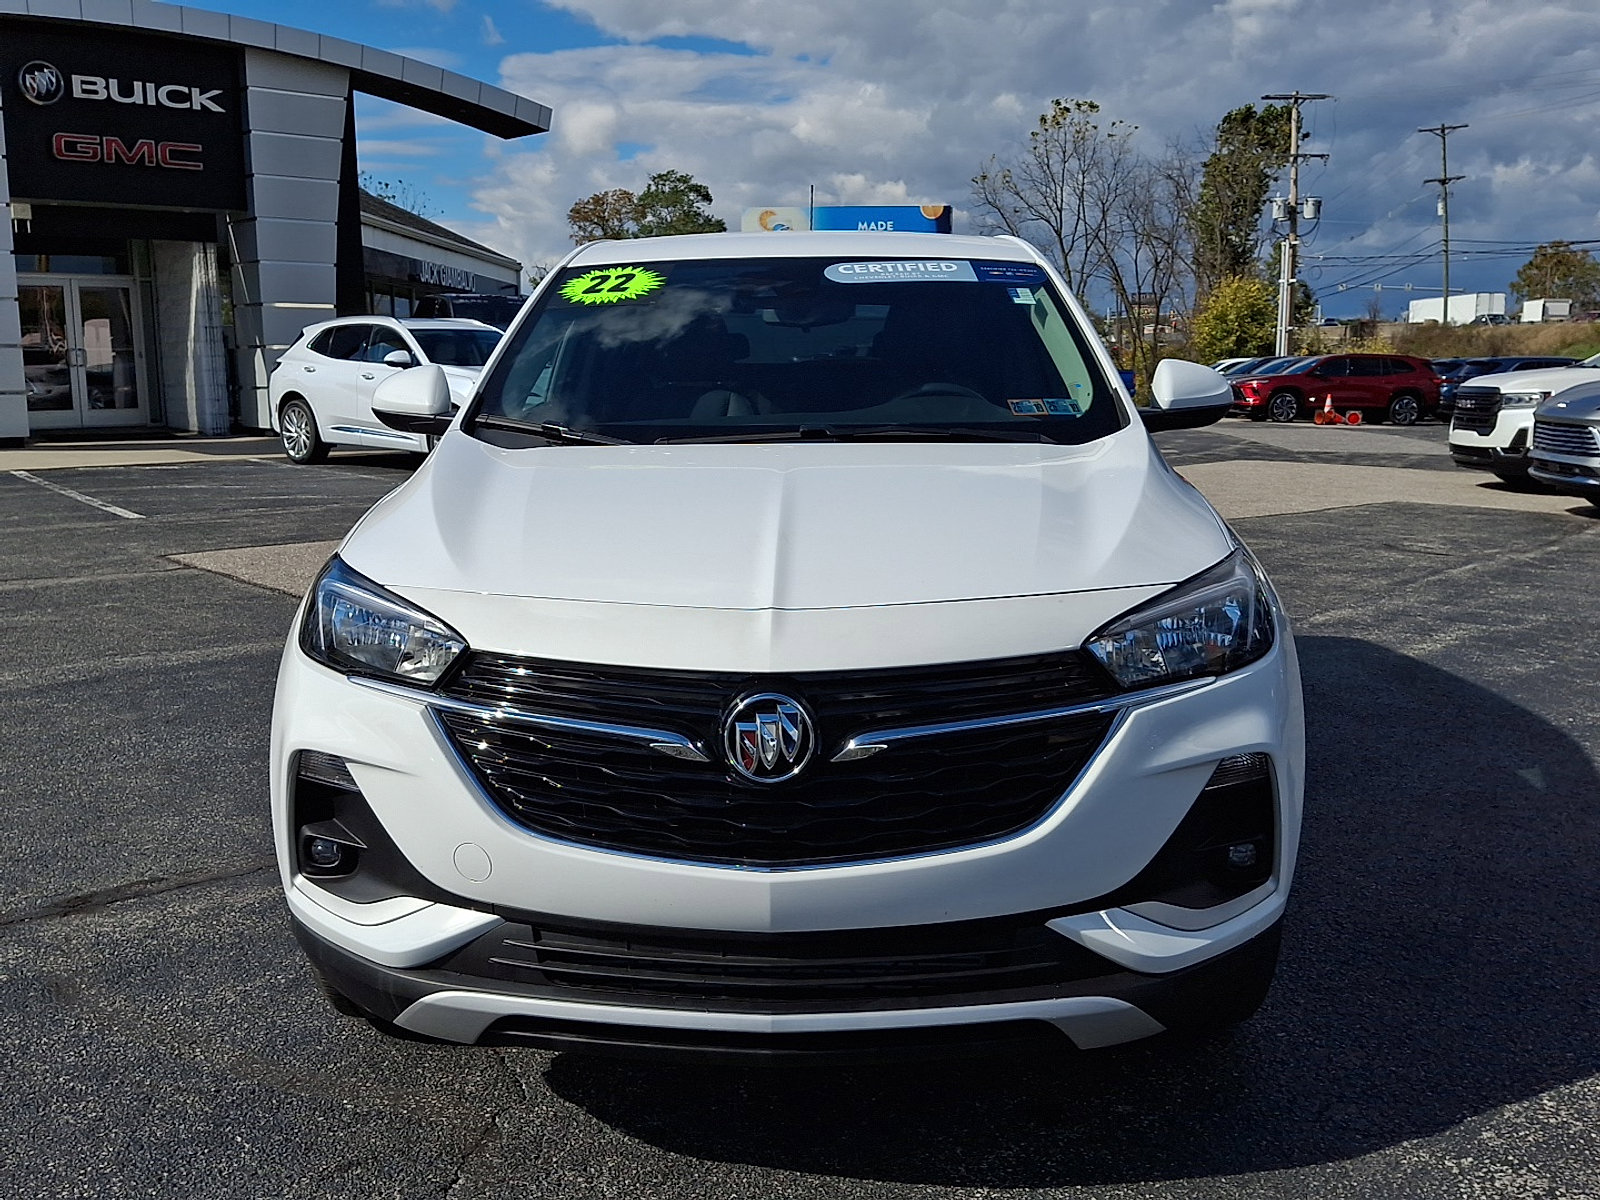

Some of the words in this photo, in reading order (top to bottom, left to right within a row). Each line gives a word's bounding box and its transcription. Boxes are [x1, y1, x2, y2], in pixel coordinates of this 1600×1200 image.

[71, 74, 226, 113] BUICK
[52, 132, 204, 170] GMC
[857, 221, 894, 231] MADE
[420, 260, 439, 285] JACK
[838, 262, 958, 274] CERTIFIED
[581, 273, 637, 295] 22
